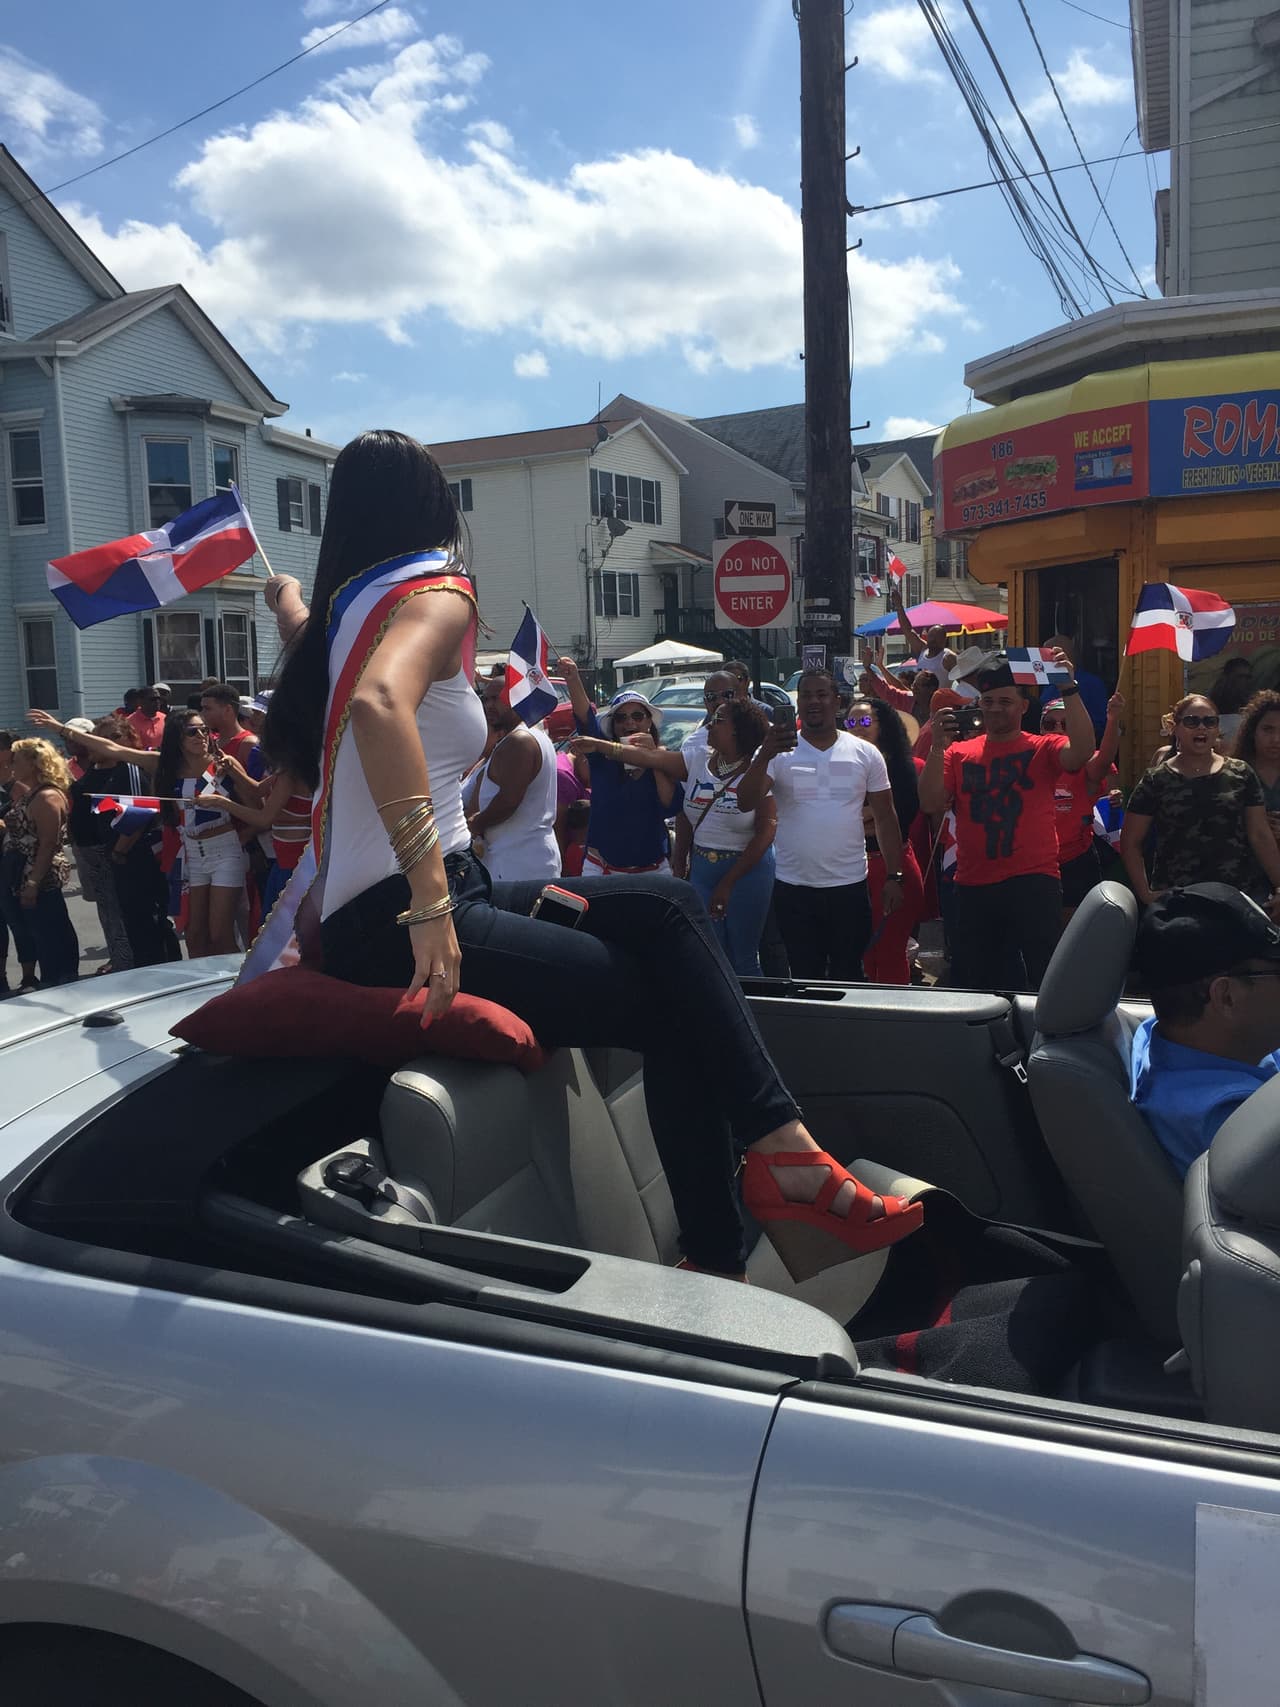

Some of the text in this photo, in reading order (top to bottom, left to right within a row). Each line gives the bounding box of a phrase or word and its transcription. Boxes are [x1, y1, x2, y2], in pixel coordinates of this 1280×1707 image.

[1073, 423, 1133, 449] WE ACCEPT
[1182, 399, 1280, 458] ROM
[991, 439, 1014, 461] 186
[1183, 467, 1209, 488] FRESH
[1210, 464, 1240, 487] FRUITS
[962, 490, 1047, 522] 973-341-7455
[739, 511, 771, 527] ONE WAY
[725, 556, 778, 572] DO NOT
[731, 596, 774, 611] ENTER
